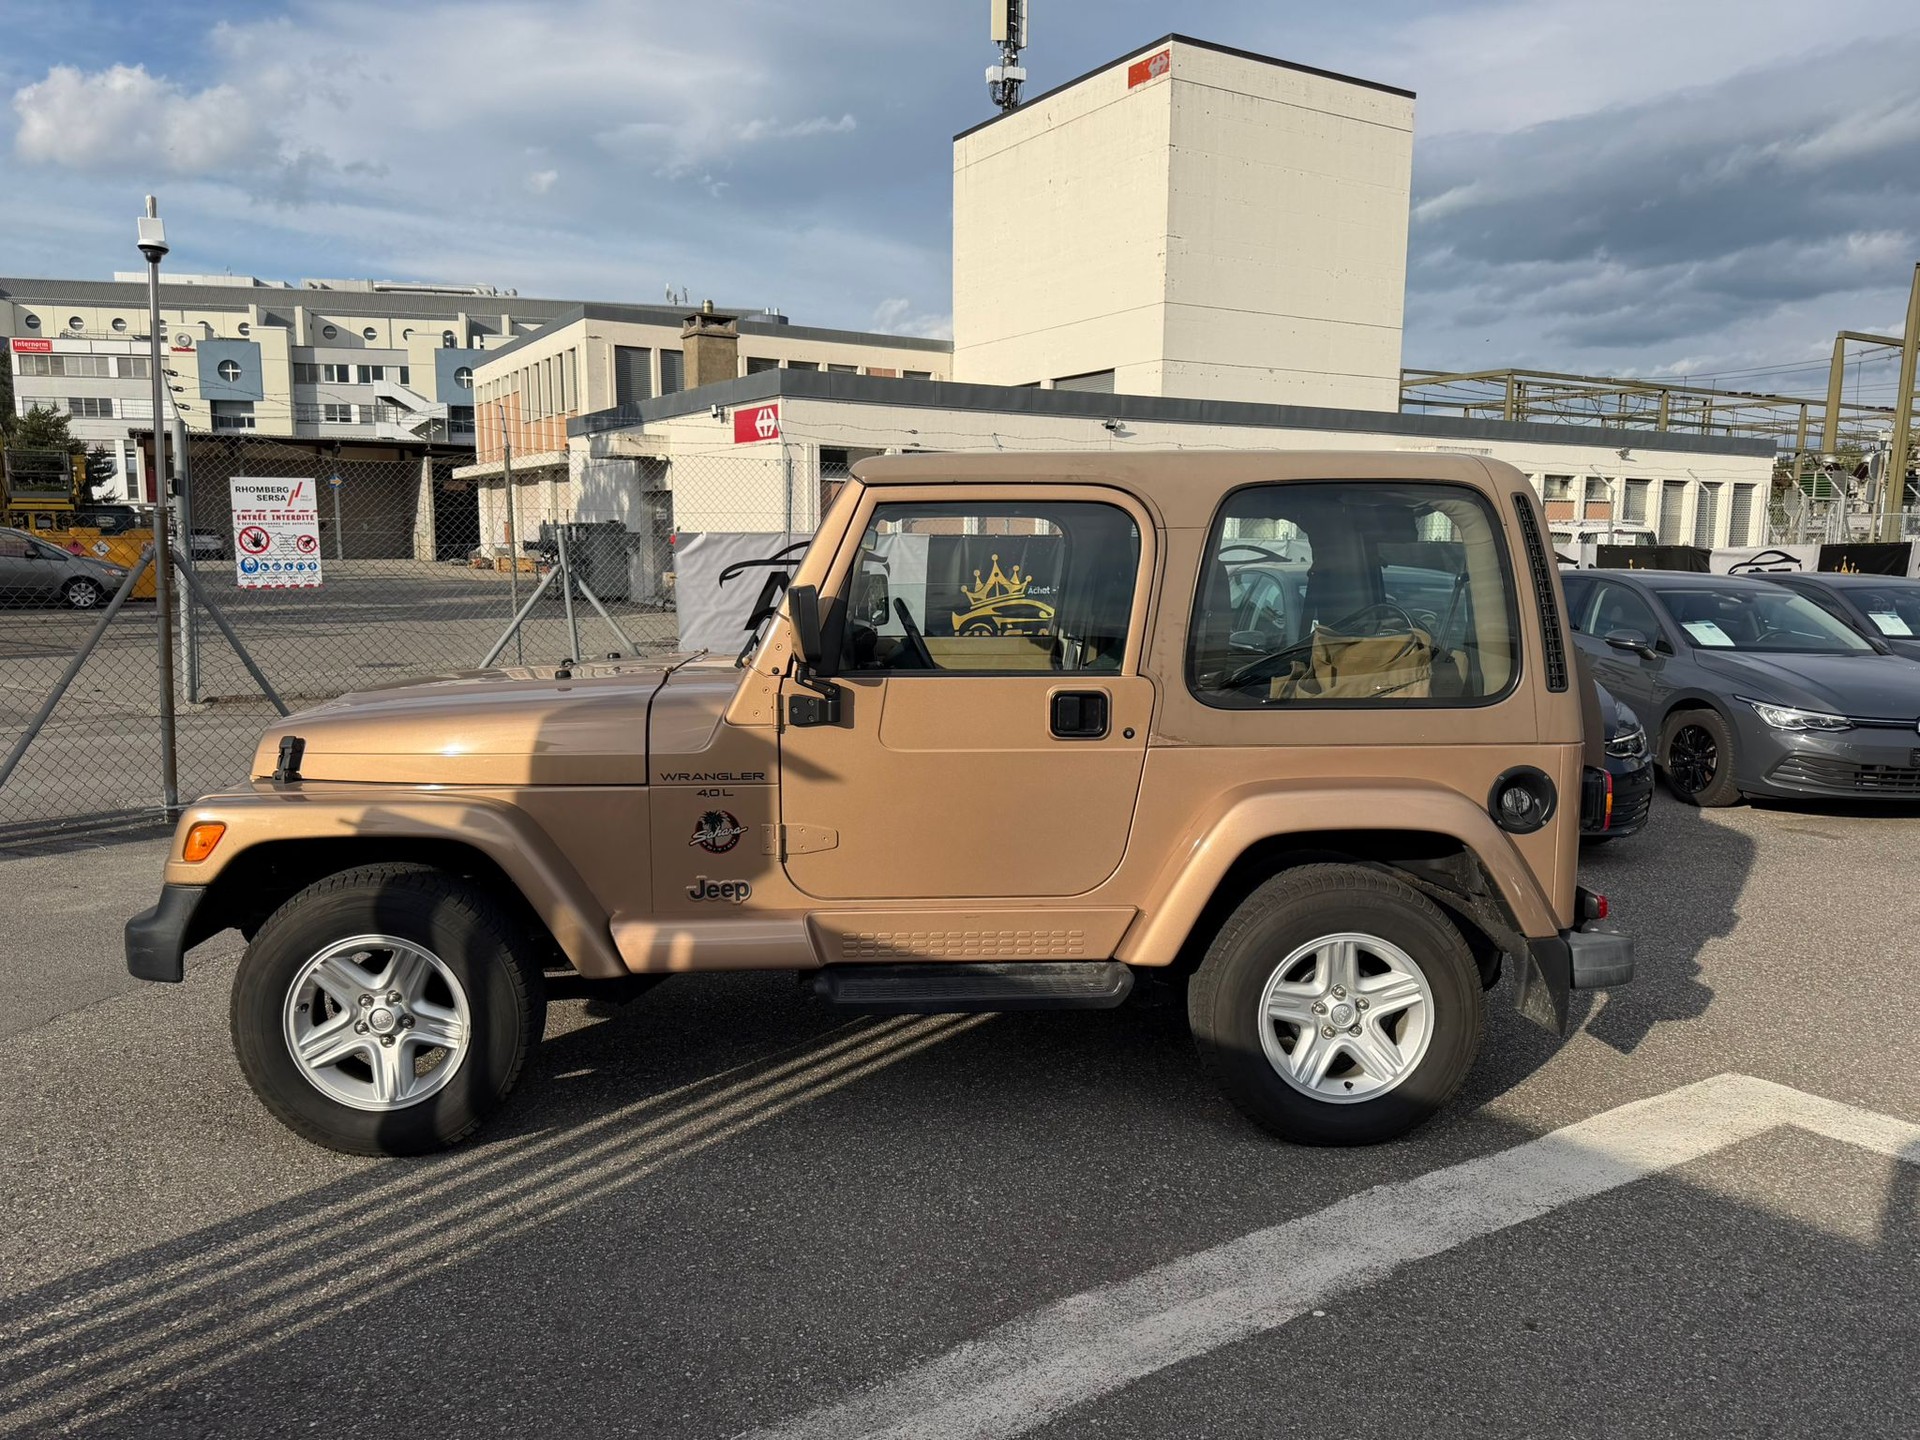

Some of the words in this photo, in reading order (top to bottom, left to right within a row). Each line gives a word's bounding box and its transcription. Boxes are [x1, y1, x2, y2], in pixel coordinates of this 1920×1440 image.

[660, 772, 765, 781] WRANGLER
[689, 826, 748, 846] Sahara
[689, 879, 751, 902] Jeep
